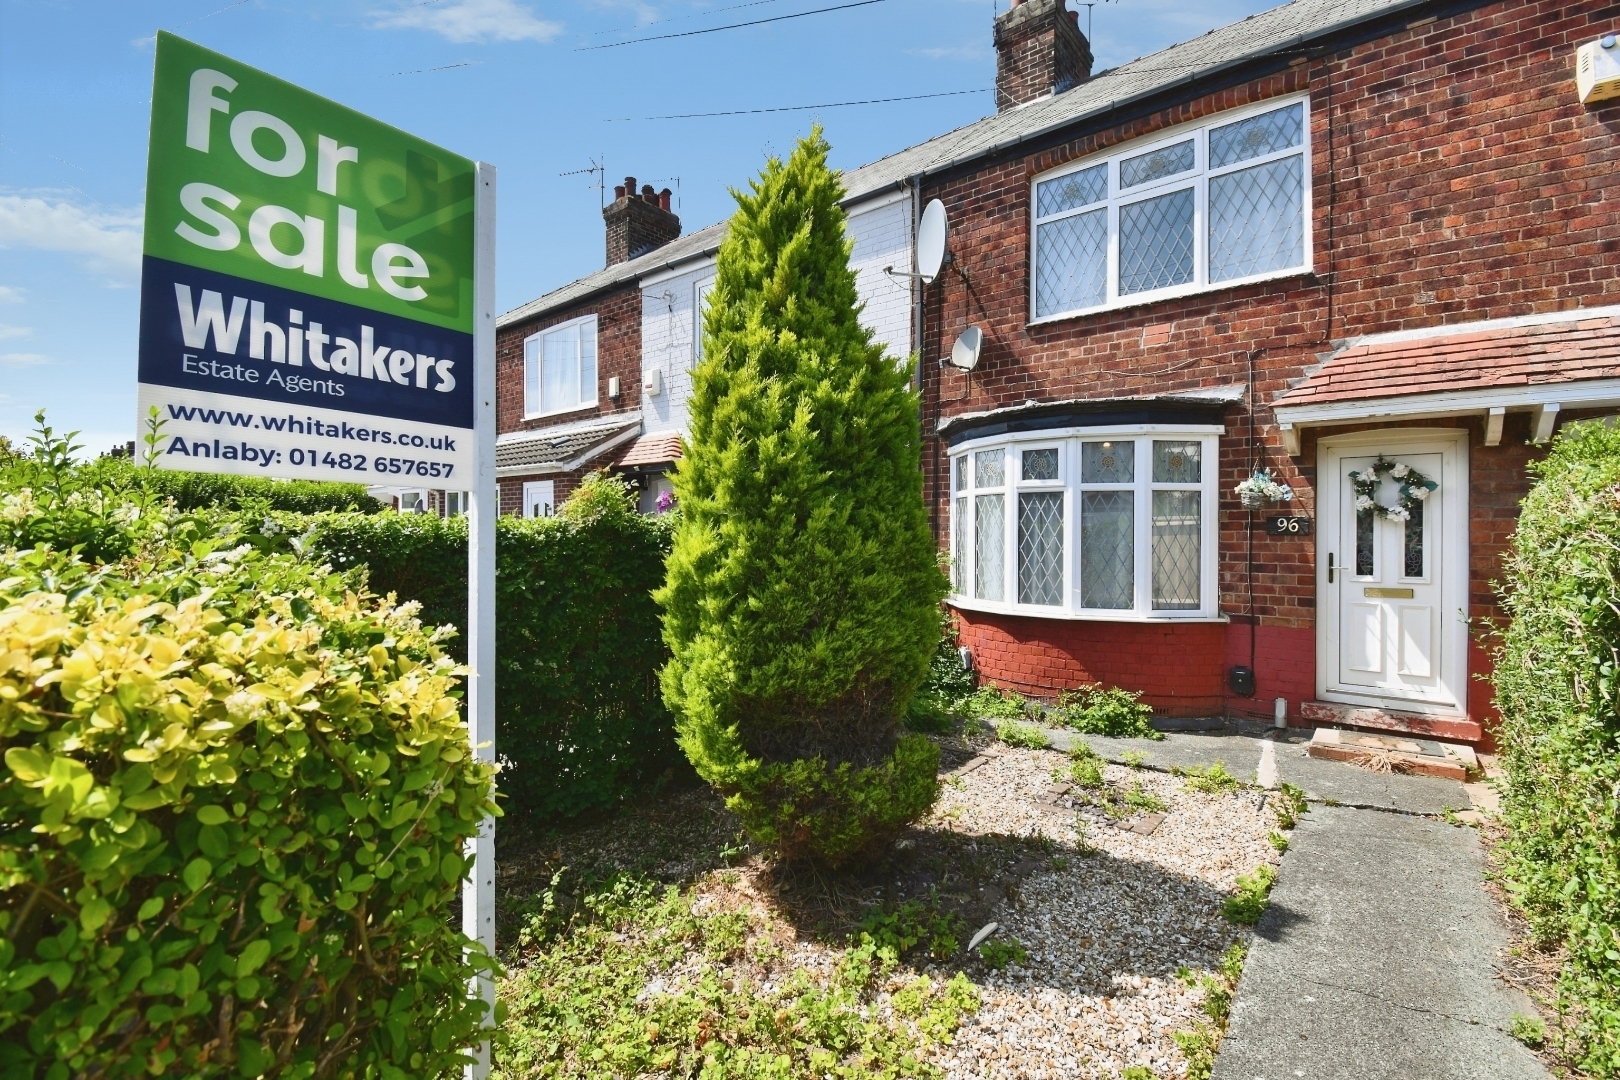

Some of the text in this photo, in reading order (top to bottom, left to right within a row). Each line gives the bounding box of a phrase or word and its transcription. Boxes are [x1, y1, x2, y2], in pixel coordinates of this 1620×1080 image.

[186, 68, 359, 196] for
[174, 182, 430, 301] sale
[174, 282, 456, 393] Whitakers
[182, 353, 345, 397] Estate Agents
[167, 404, 456, 452] www.whitakers.co.uk
[166, 436, 454, 479] Anlaby: 01482 657657
[1277, 518, 1299, 532] 96
